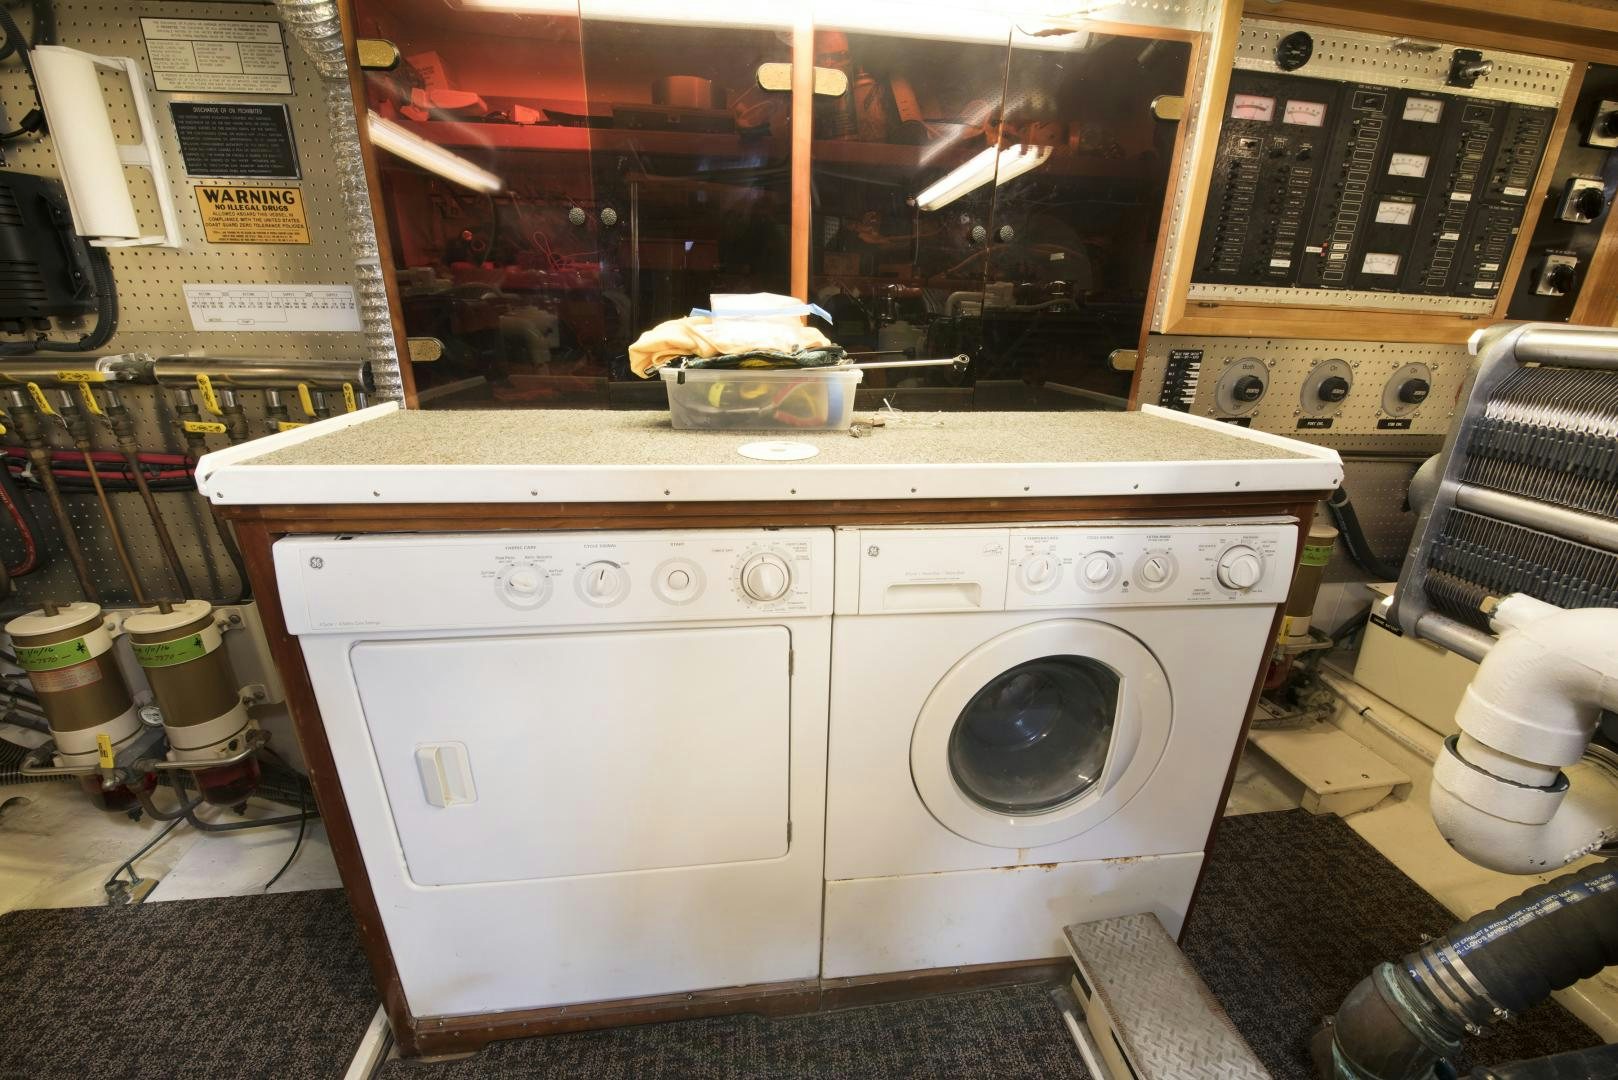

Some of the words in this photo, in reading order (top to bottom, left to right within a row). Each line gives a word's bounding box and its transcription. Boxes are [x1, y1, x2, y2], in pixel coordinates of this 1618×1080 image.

[192, 106, 219, 114] DISCHARGE
[202, 189, 295, 205] WARNING
[1460, 930, 1484, 944] EXHAUST
[1488, 919, 1509, 930] WATER
[1508, 910, 1523, 921] HOSE
[1487, 921, 1519, 938] APPROVED
